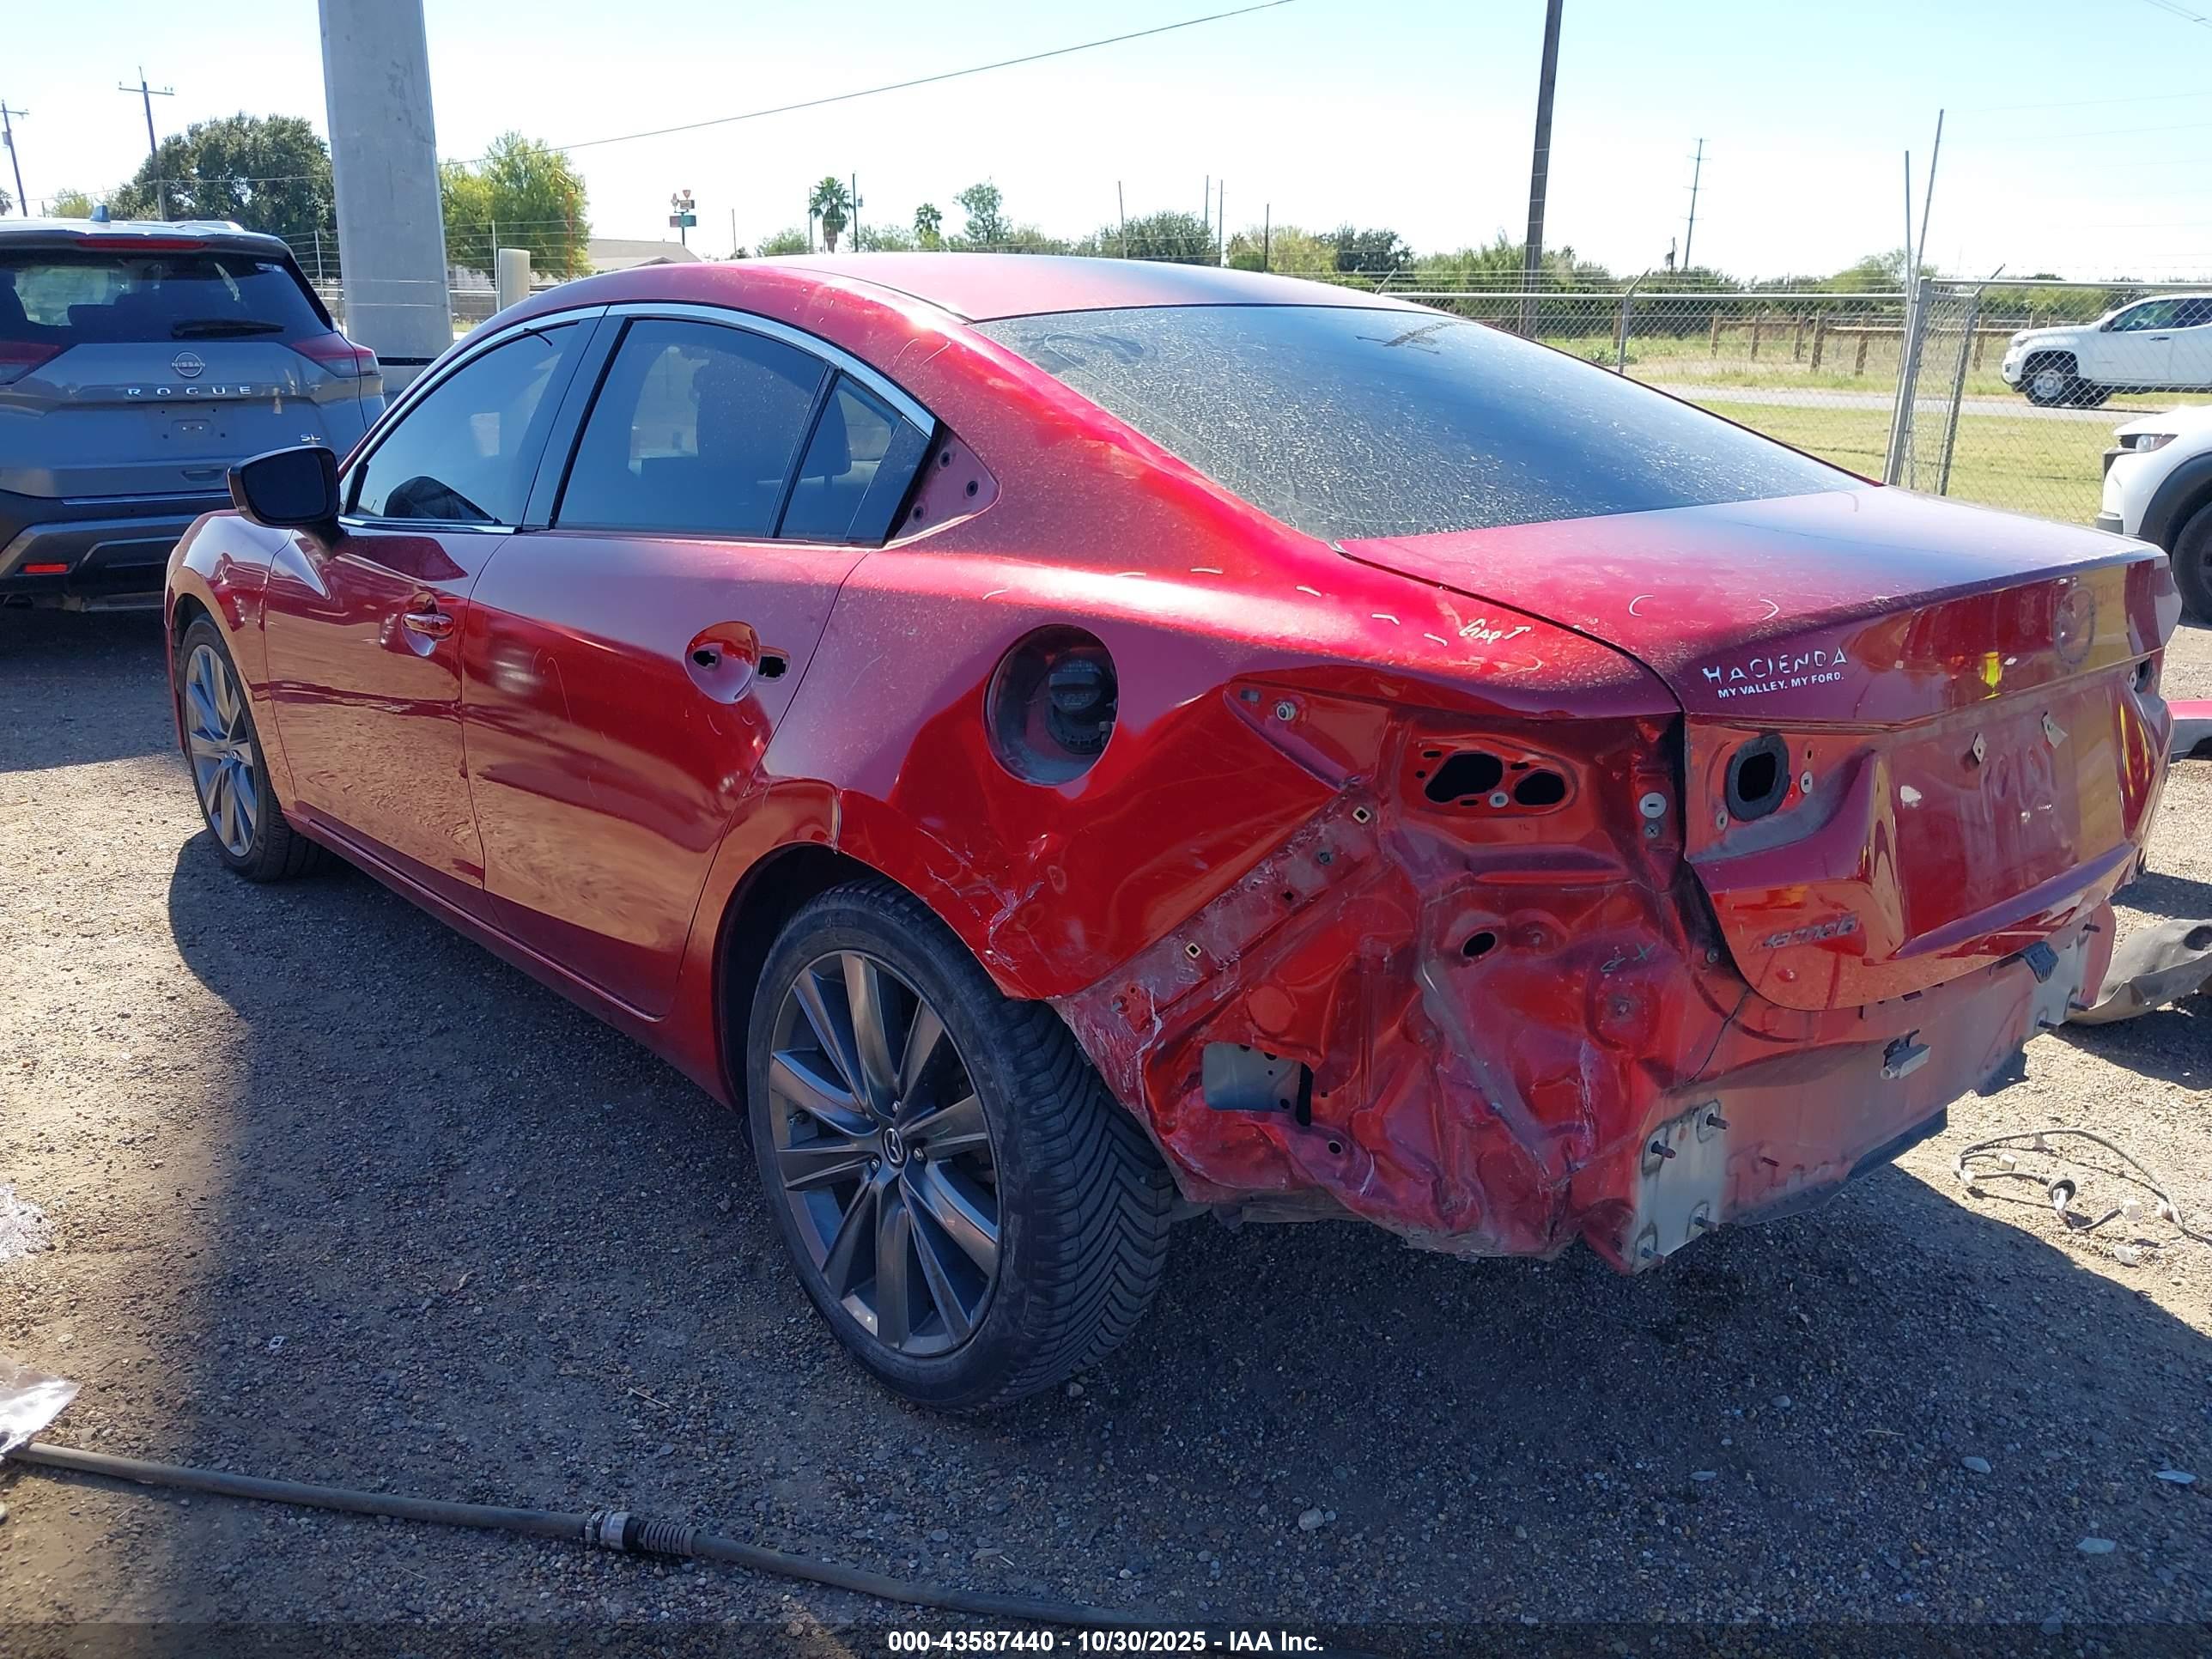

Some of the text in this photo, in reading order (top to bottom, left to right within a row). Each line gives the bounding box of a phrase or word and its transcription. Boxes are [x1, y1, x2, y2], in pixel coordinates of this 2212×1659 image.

[127, 386, 252, 397] ROGUE
[300, 433, 321, 441] SL
[1701, 647, 1848, 685] HACIENDA
[1717, 672, 1844, 699] MY VALLEY. MY FORD.
